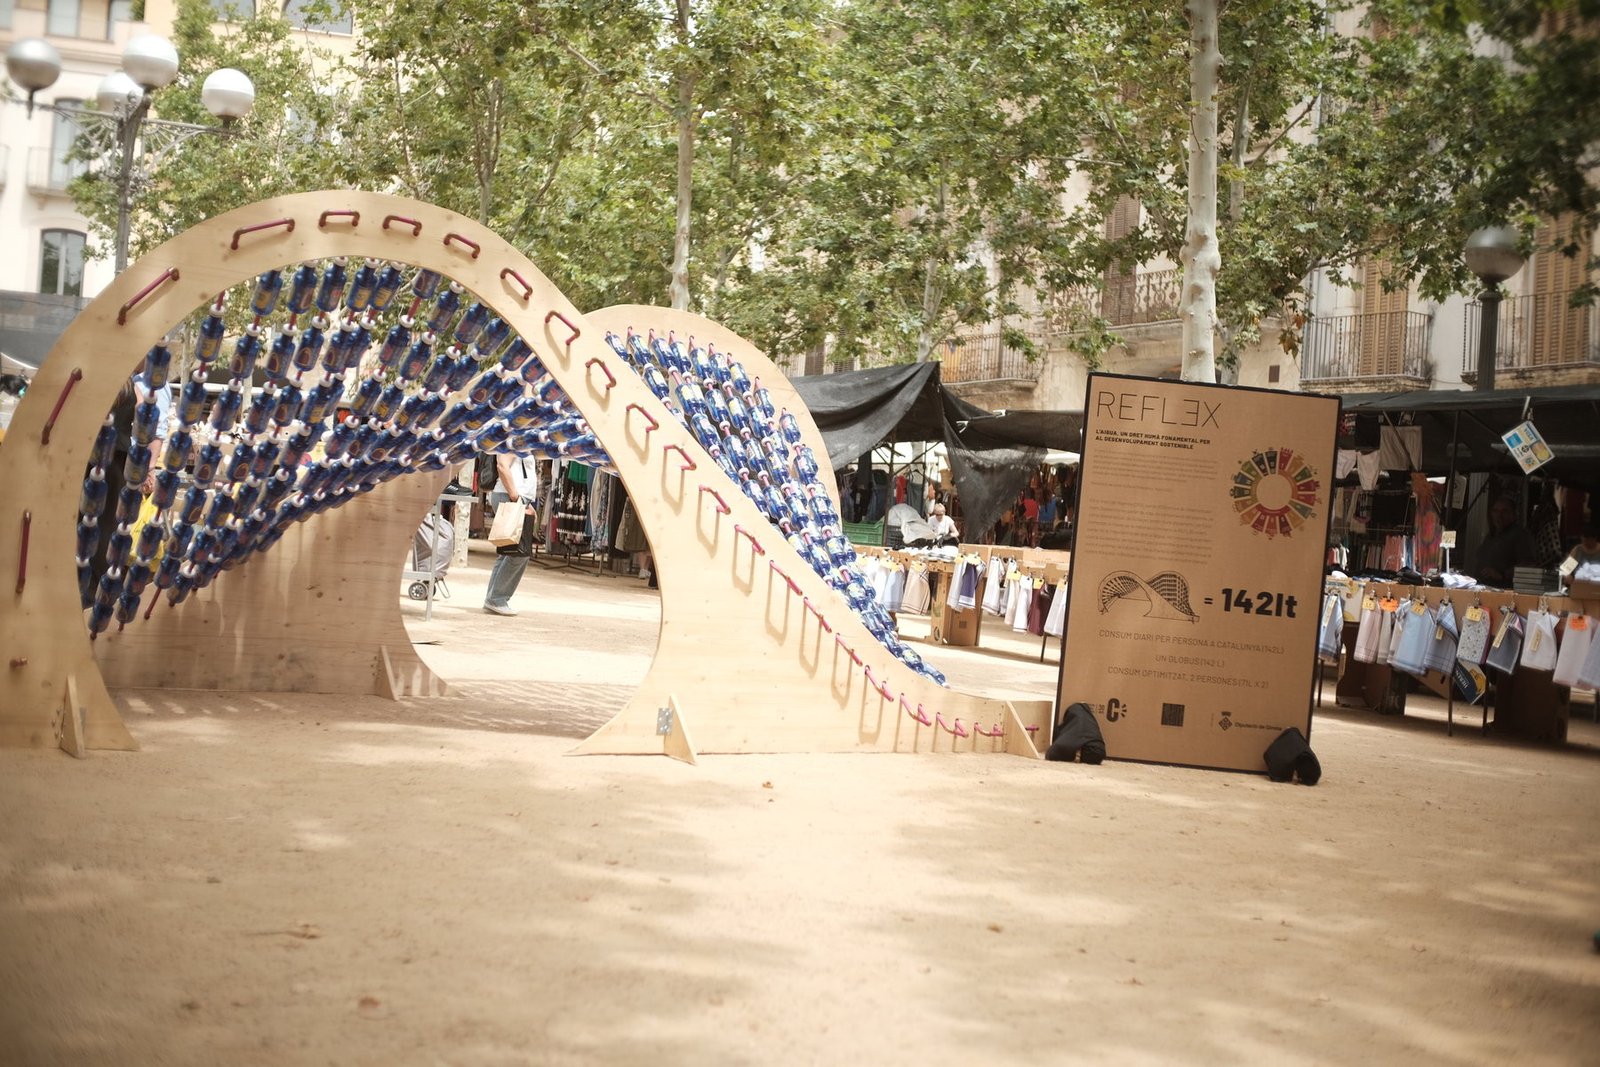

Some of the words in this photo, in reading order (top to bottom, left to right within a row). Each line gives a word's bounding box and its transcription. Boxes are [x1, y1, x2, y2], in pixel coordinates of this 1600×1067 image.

[1104, 437, 1158, 446] DESENVOLUPAMENT
[1161, 435, 1198, 443] FONAMENTAL
[1098, 629, 1132, 639] CONSUM
[1134, 633, 1154, 641] DIARI
[1155, 635, 1171, 643] PER
[1172, 636, 1208, 647] PERSONA
[1216, 641, 1262, 652] CATALUNYA
[1168, 656, 1200, 665] GLOBUS
[1107, 666, 1141, 676] CONSUM
[1190, 674, 1195, 682] 2
[1196, 675, 1238, 686] PERSONES
